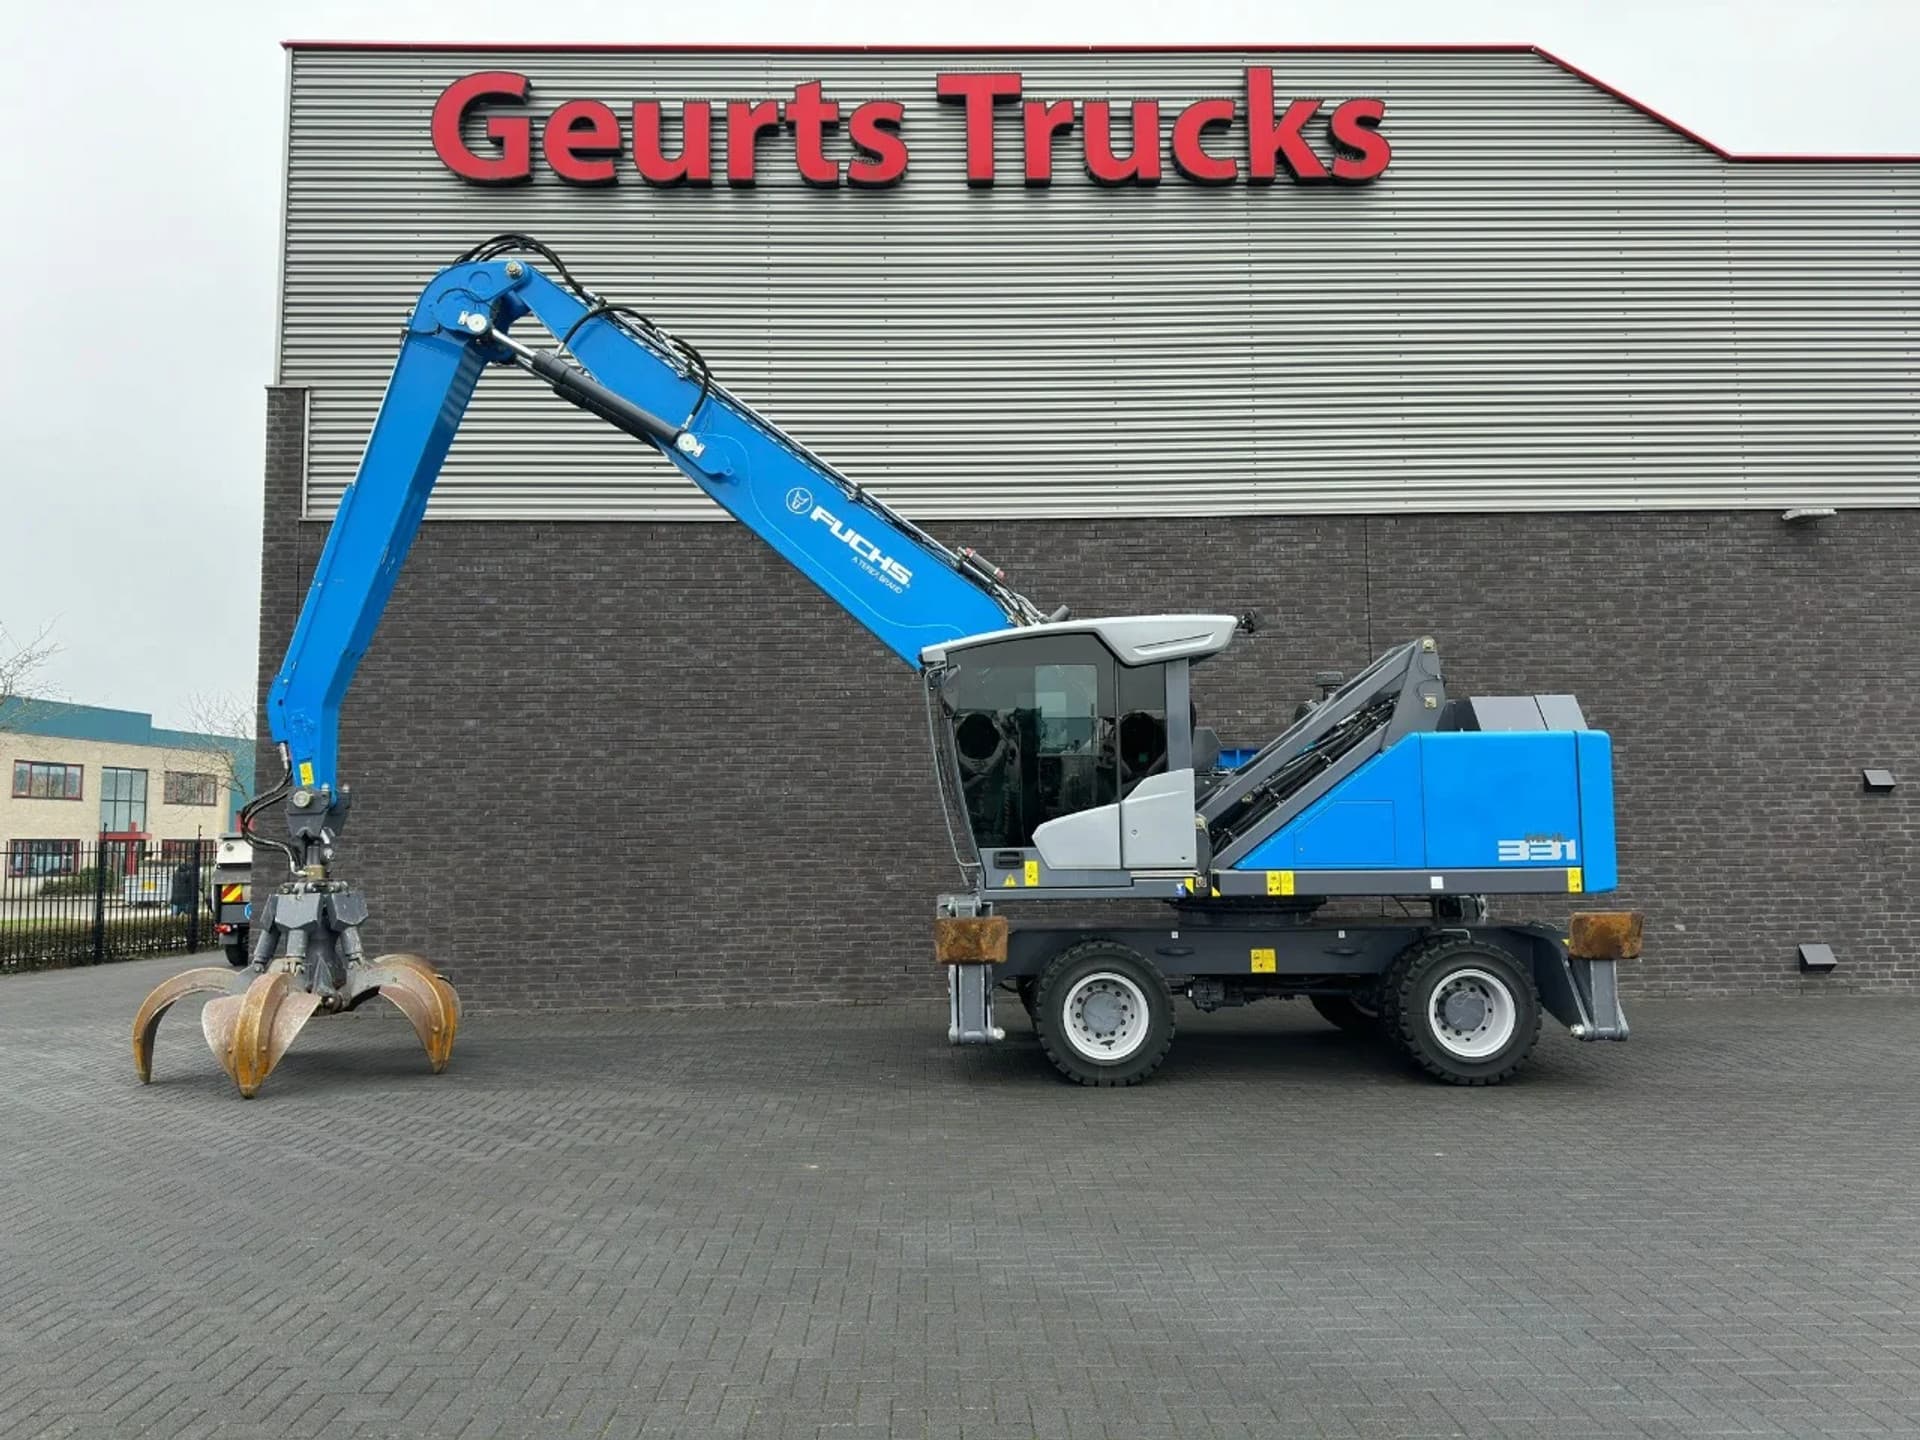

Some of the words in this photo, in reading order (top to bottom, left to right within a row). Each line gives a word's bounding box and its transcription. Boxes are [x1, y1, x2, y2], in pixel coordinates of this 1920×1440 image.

[431, 70, 910, 188] Geurts
[936, 67, 1393, 187] Trucks
[810, 505, 913, 585] FUCHS
[1498, 839, 1576, 861] 331
